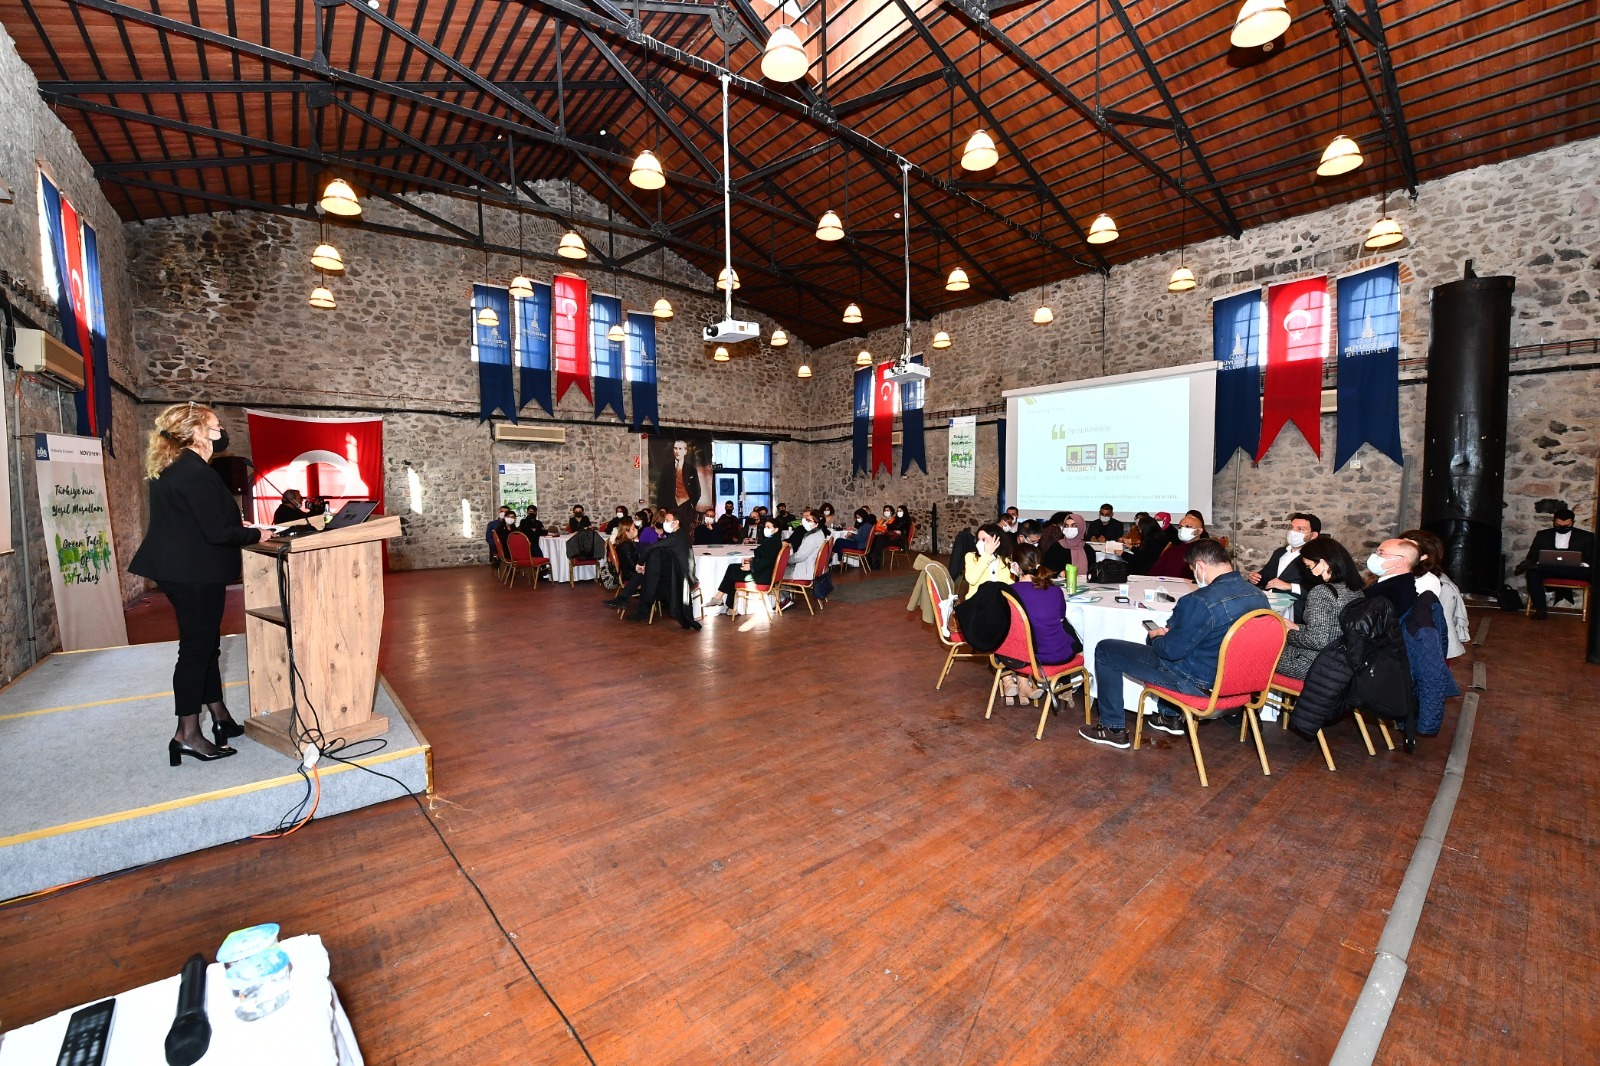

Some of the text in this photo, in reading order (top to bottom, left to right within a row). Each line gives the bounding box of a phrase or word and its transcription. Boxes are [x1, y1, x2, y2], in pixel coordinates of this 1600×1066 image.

[1106, 459, 1127, 472] BIG
[62, 538, 84, 549] Green
[76, 573, 100, 586] Turkey
